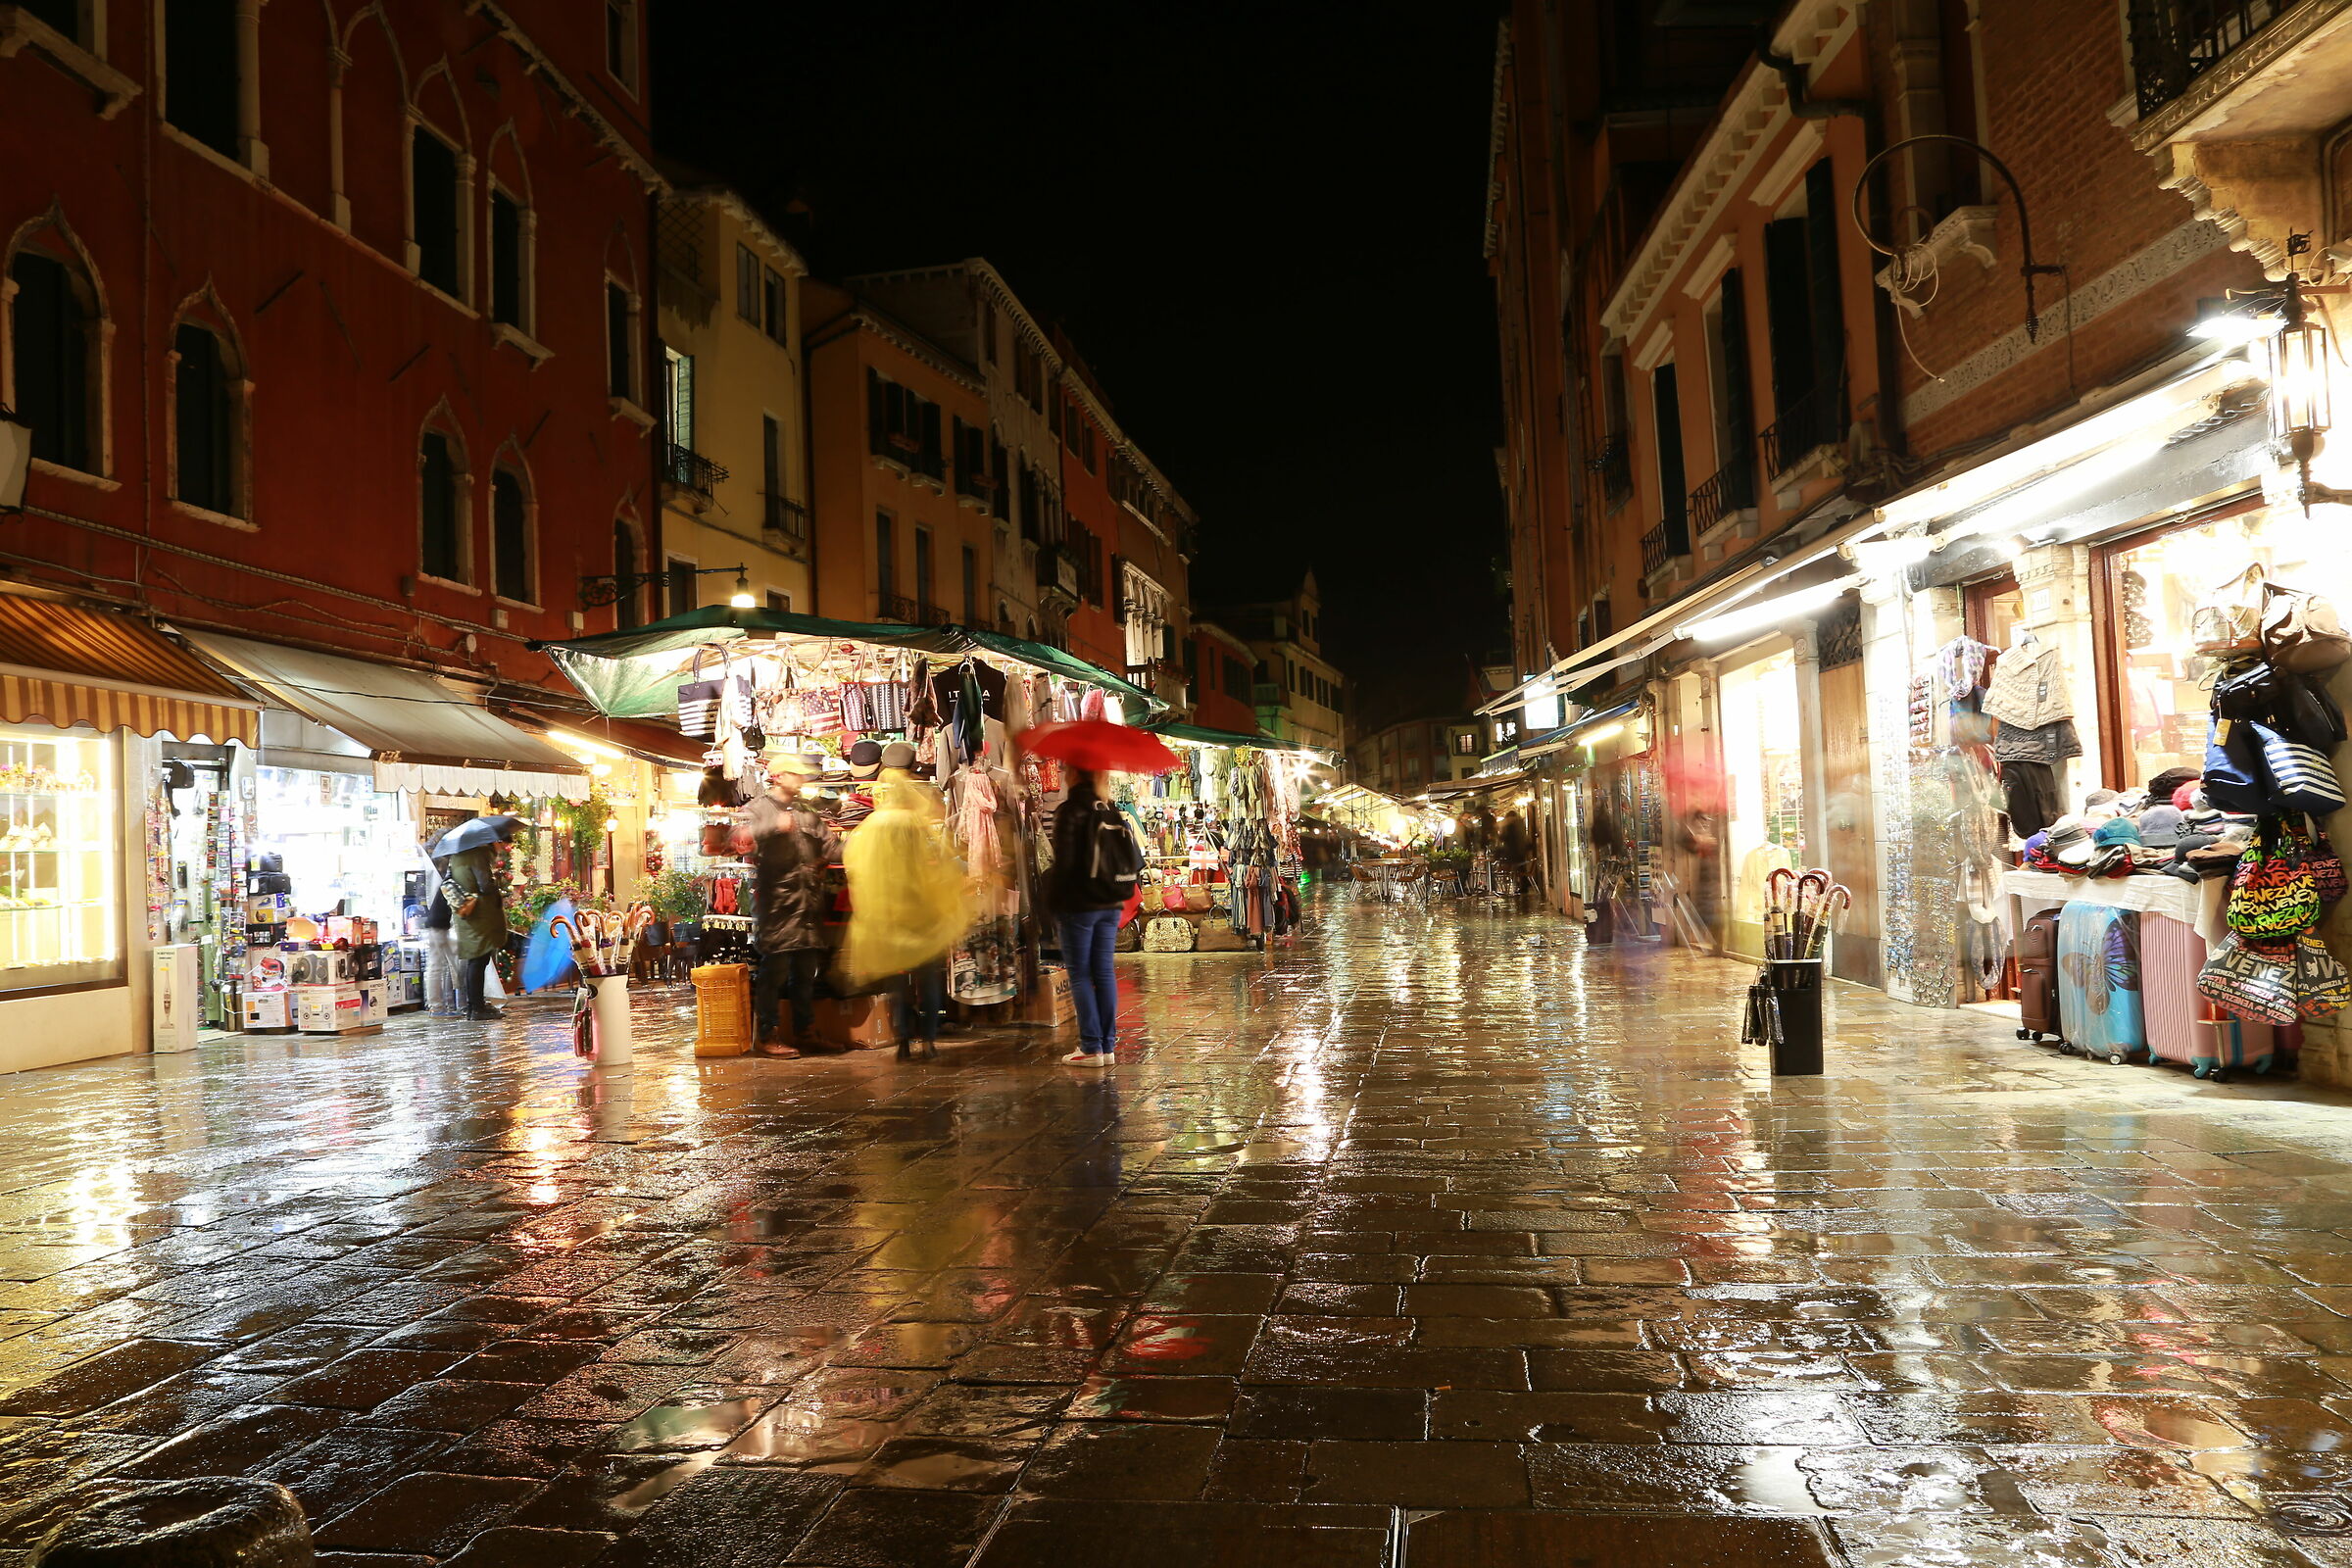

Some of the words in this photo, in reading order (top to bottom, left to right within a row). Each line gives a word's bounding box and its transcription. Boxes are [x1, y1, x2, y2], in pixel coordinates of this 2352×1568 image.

[2213, 968, 2236, 979] VENEZIA
[2206, 980, 2233, 994] VENEZIA
[2238, 982, 2275, 1002] VENEZIA
